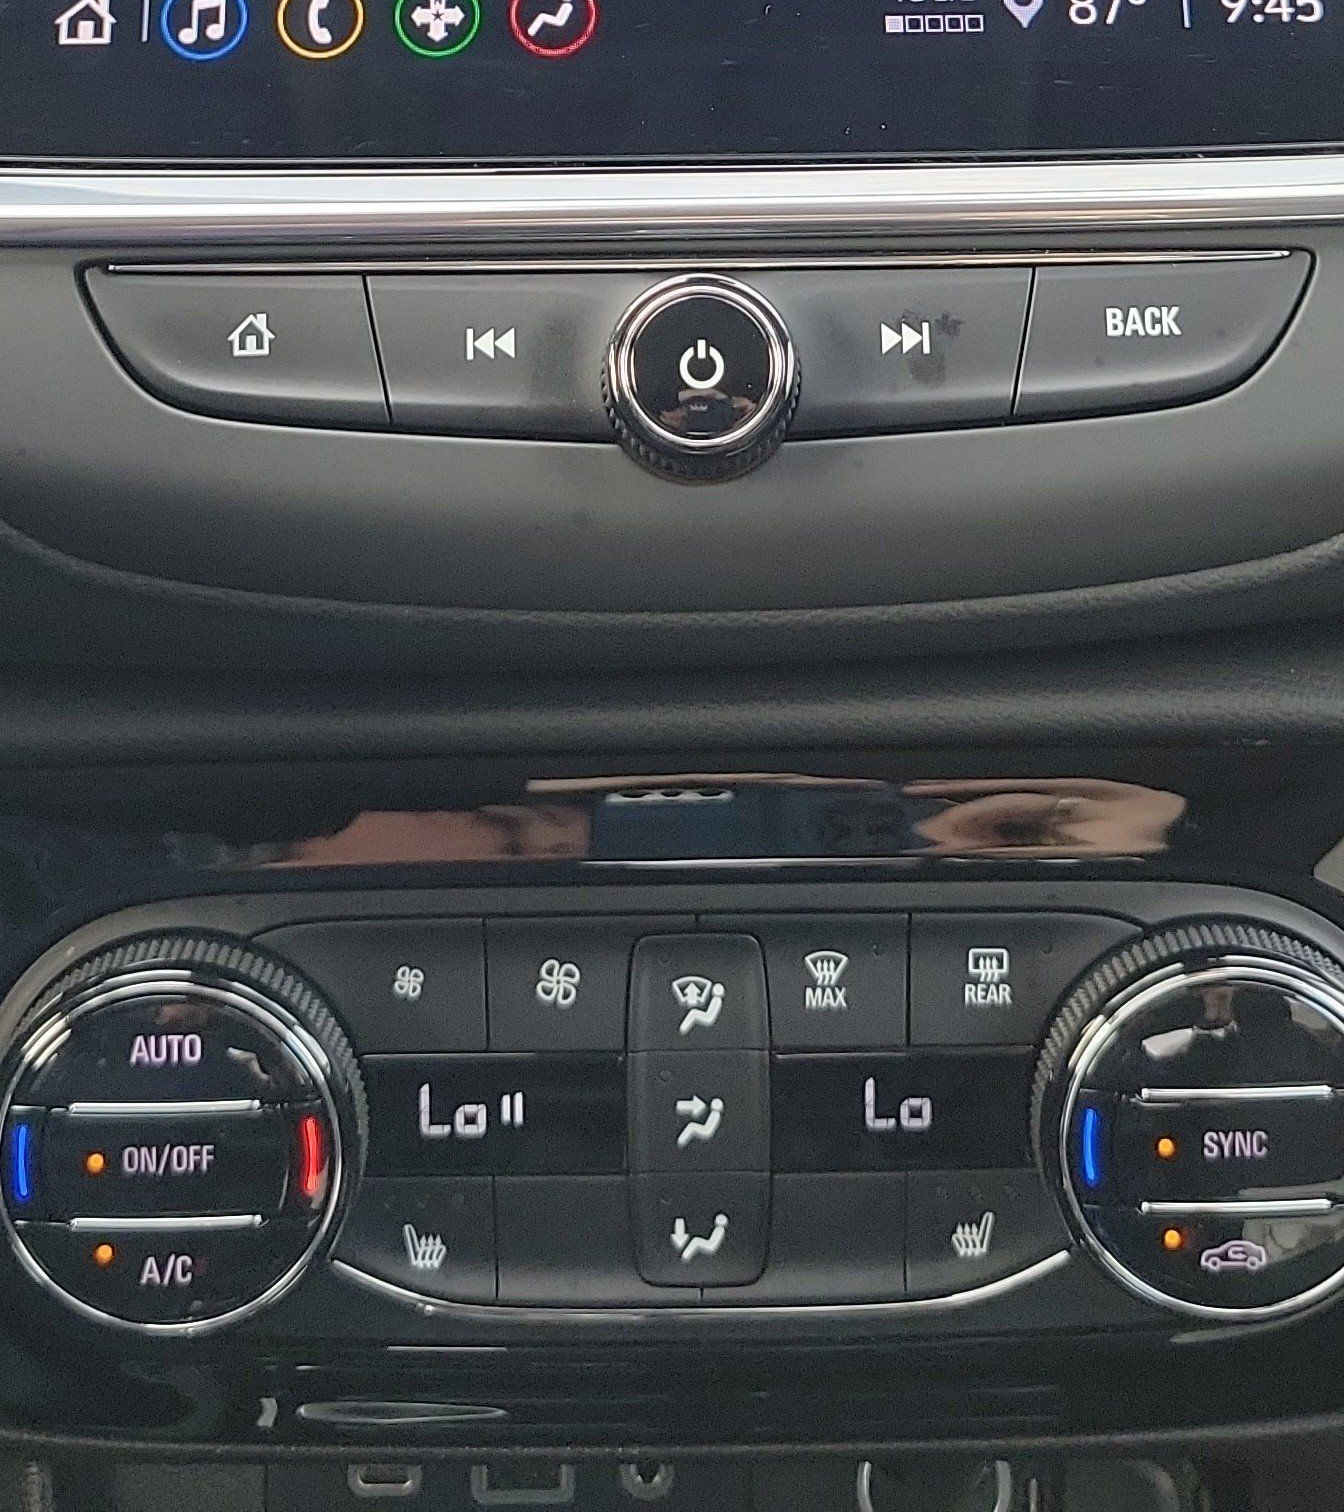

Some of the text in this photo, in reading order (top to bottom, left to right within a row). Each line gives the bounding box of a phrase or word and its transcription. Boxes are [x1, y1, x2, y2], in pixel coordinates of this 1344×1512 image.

[1105, 306, 1181, 337] BACK
[805, 987, 846, 1007] MAX
[964, 984, 1011, 1004] REAR
[130, 1034, 202, 1064] AUTO
[419, 1083, 487, 1137] Lo
[864, 1077, 932, 1130] Lo
[123, 1144, 214, 1175] ON/OFF
[1203, 1131, 1267, 1158] SYNC
[140, 1254, 192, 1286] A/C
